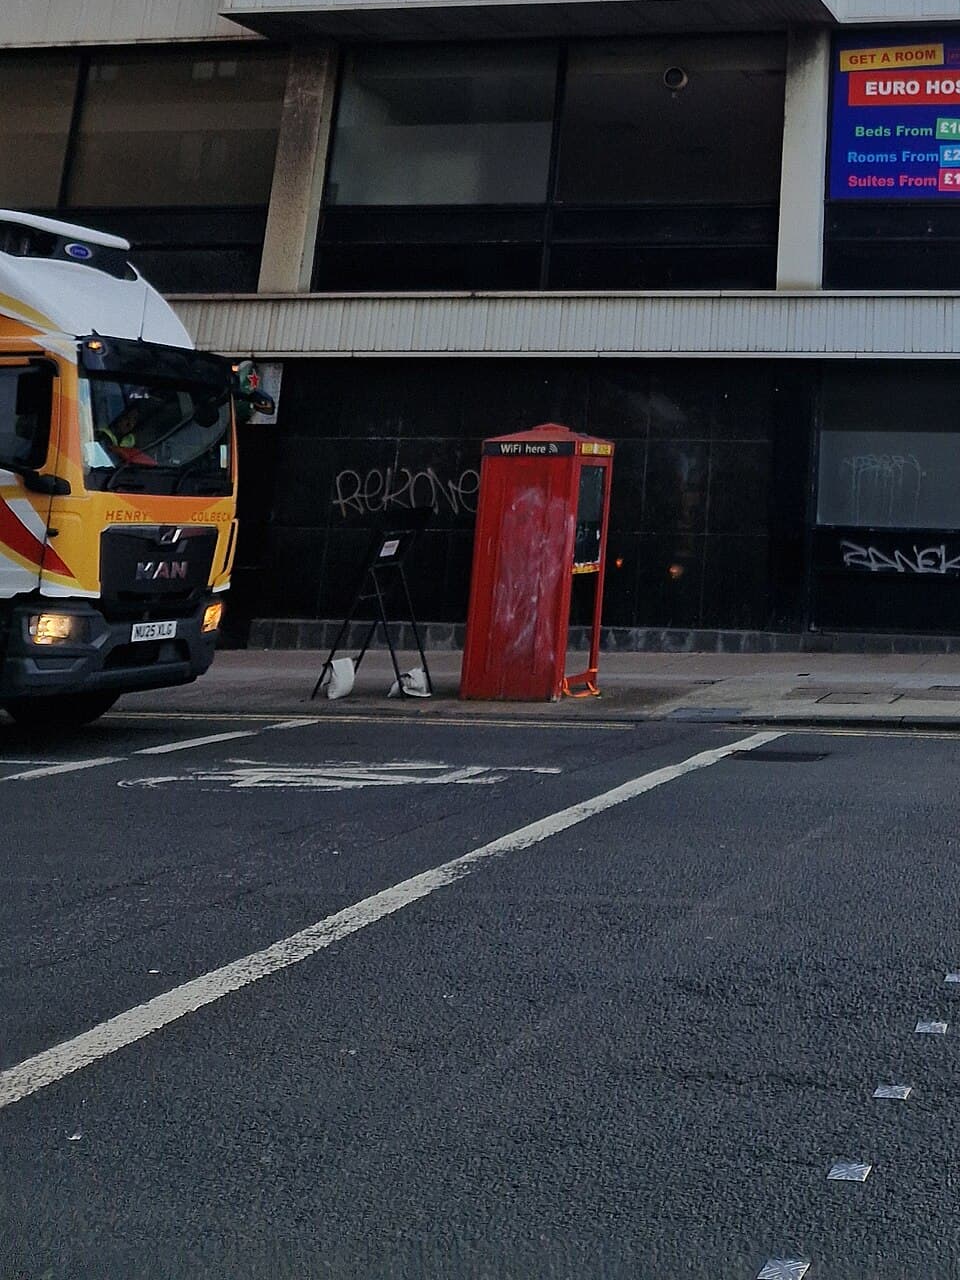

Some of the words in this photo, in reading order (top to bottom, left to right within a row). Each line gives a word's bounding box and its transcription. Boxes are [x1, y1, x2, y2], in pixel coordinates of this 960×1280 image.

[849, 54, 877, 65] GET
[881, 52, 891, 64] A
[895, 49, 936, 62] ROOM
[865, 80, 921, 96] EURO
[855, 126, 892, 137] Beds
[896, 125, 933, 137] From
[847, 151, 898, 163] Rooms
[902, 151, 939, 162] From
[848, 175, 895, 187] Suites
[899, 175, 937, 187] From
[501, 443, 521, 454] WiFi
[525, 443, 546, 454] here
[105, 510, 149, 521] HENRY
[135, 561, 189, 580] MAN
